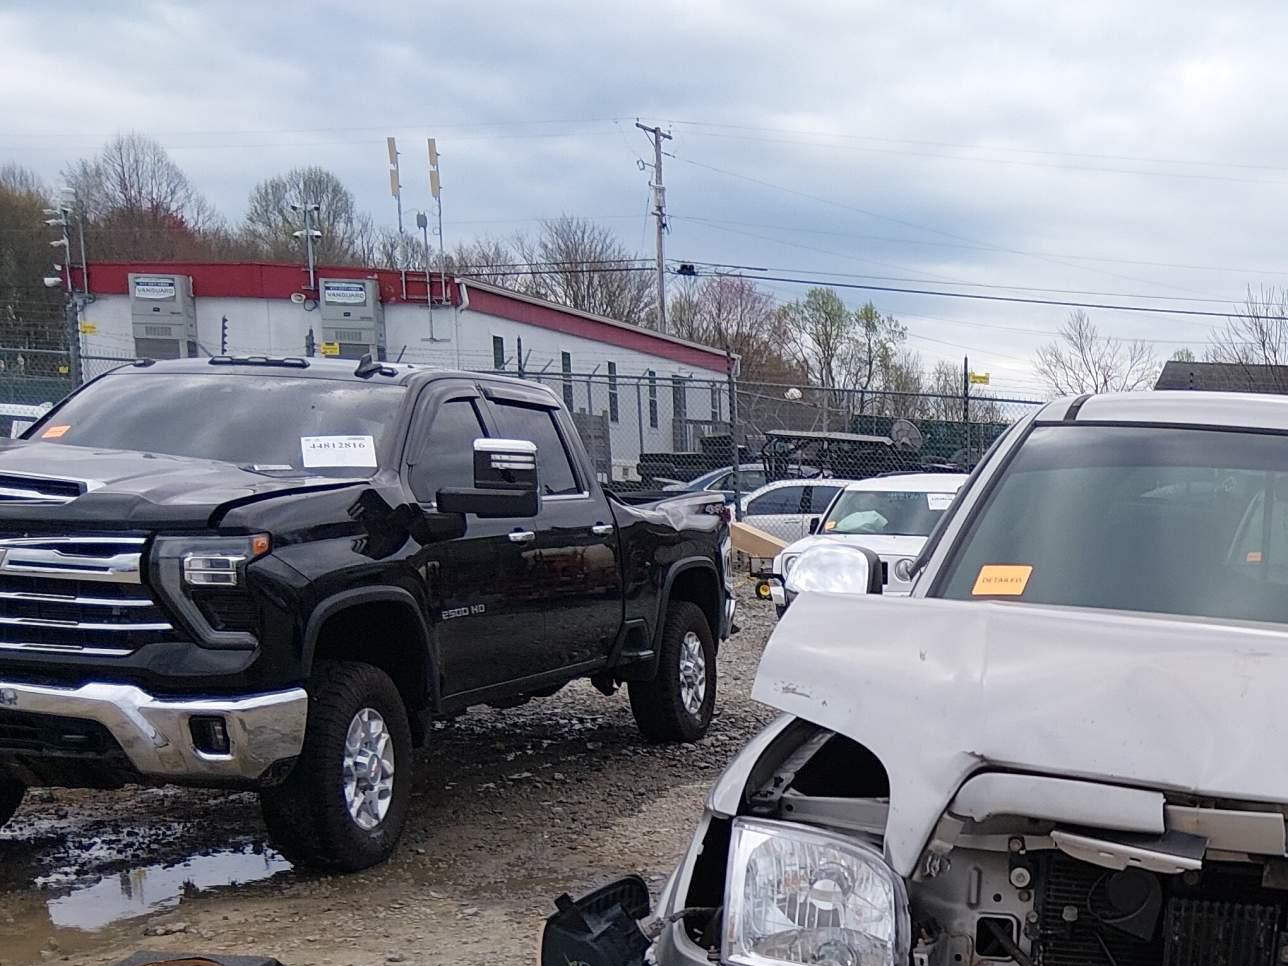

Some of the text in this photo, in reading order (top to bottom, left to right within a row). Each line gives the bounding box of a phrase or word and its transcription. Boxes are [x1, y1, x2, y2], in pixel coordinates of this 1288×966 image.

[326, 291, 365, 299] VANGUARD
[309, 441, 366, 449] 44812816
[441, 604, 486, 619] 2500 HD
